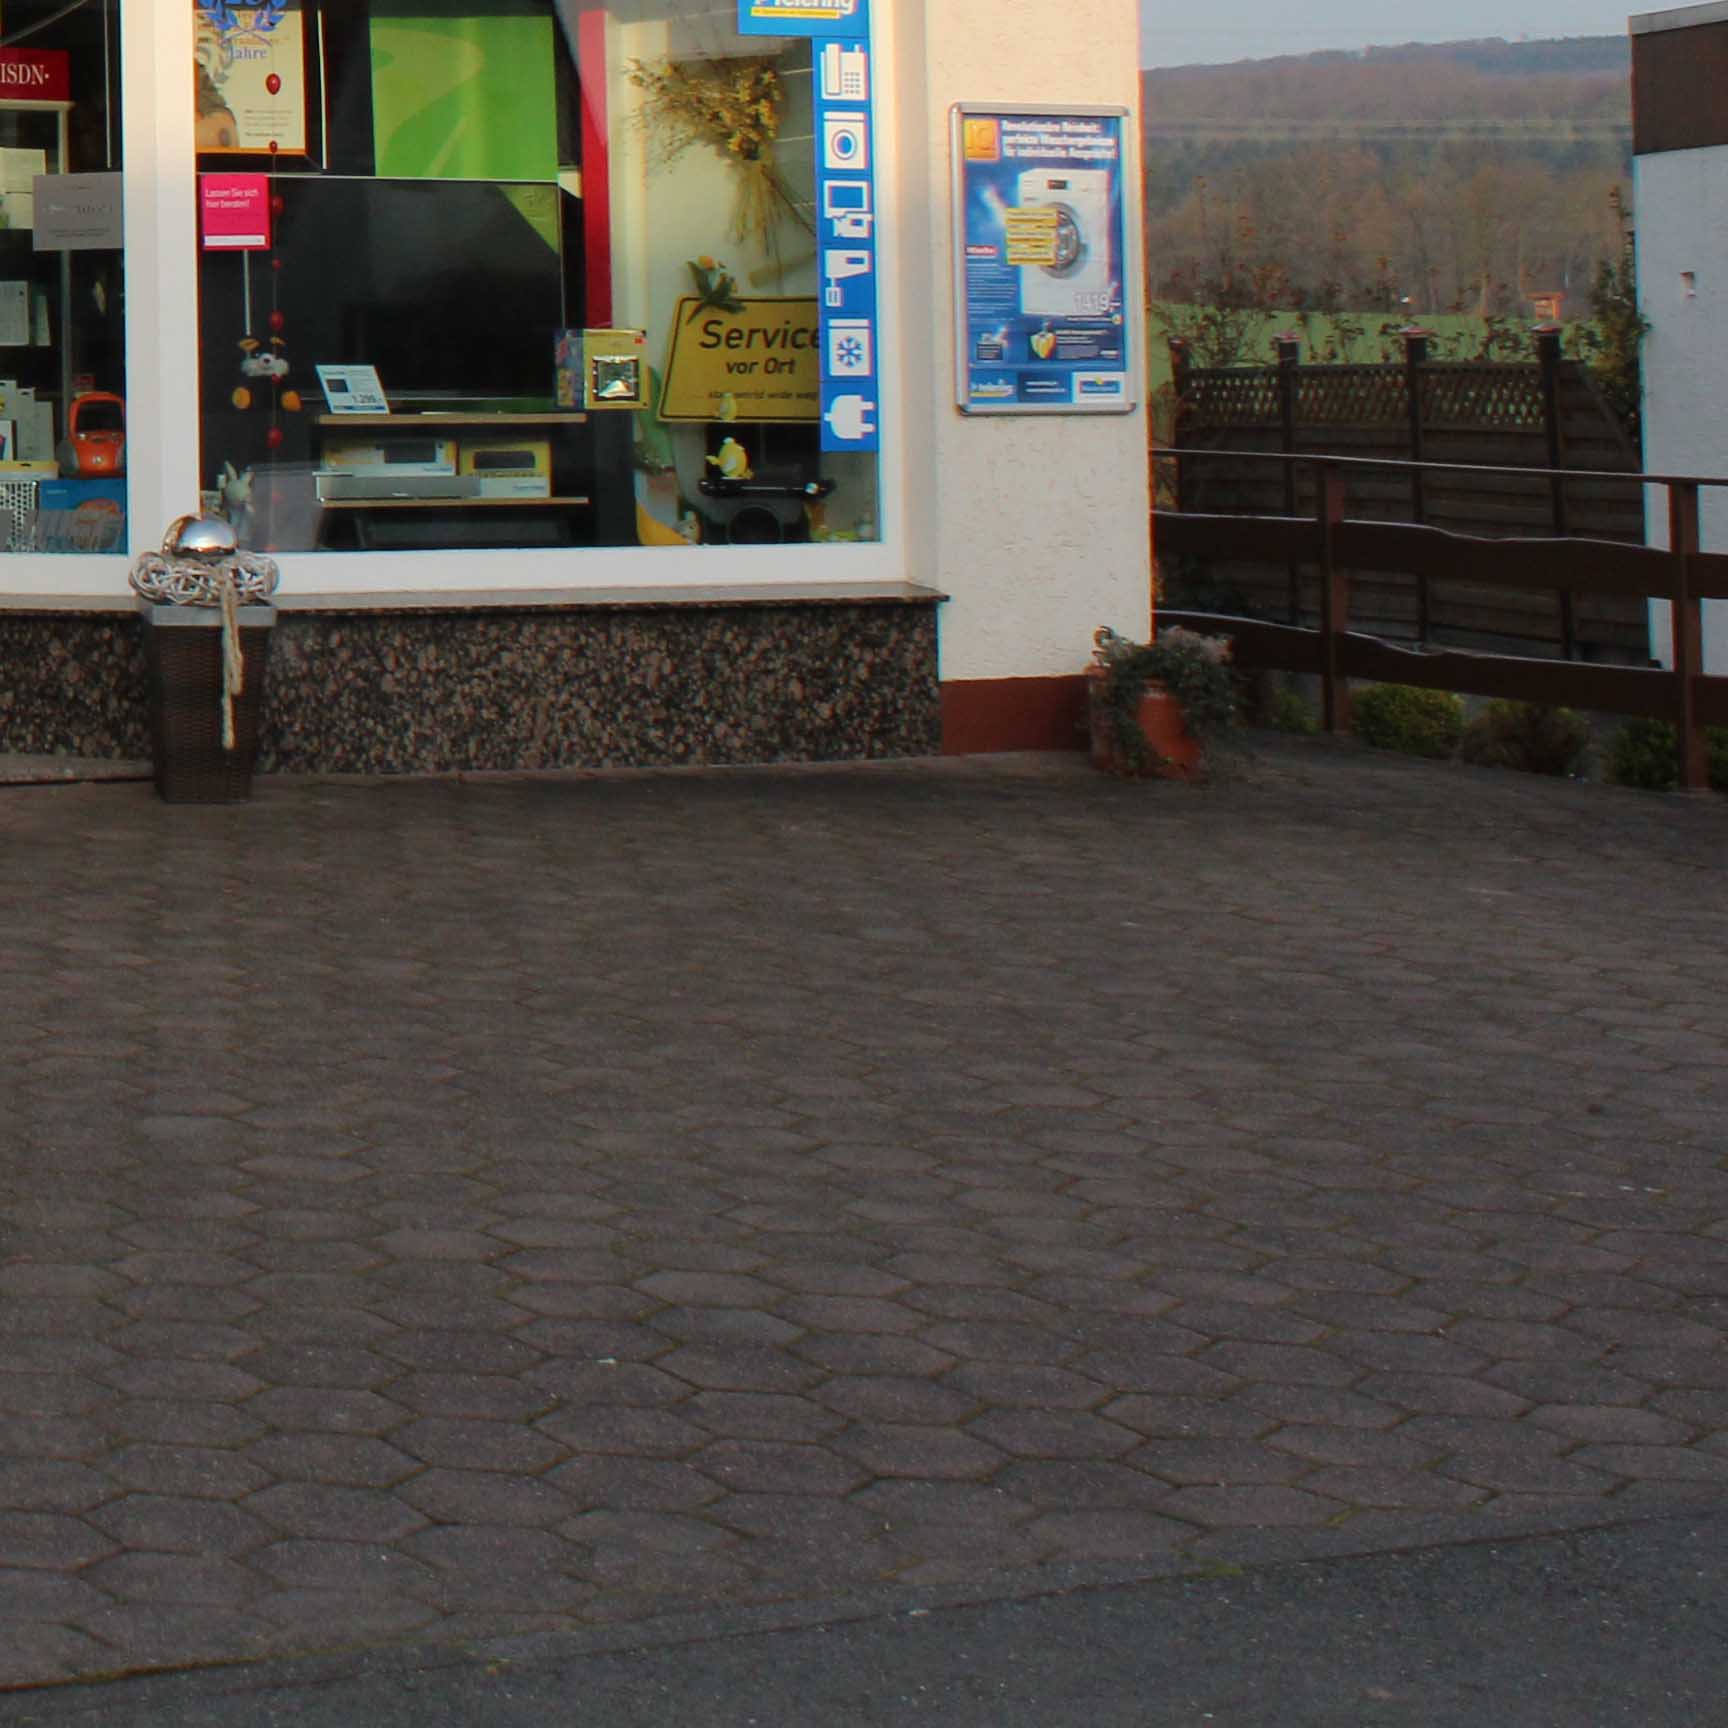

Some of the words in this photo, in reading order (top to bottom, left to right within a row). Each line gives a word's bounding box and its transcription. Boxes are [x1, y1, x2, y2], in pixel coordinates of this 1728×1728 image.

[230, 46, 267, 61] Jahre
[699, 320, 820, 350] Service
[726, 361, 758, 375] vor
[764, 358, 796, 375] Ort
